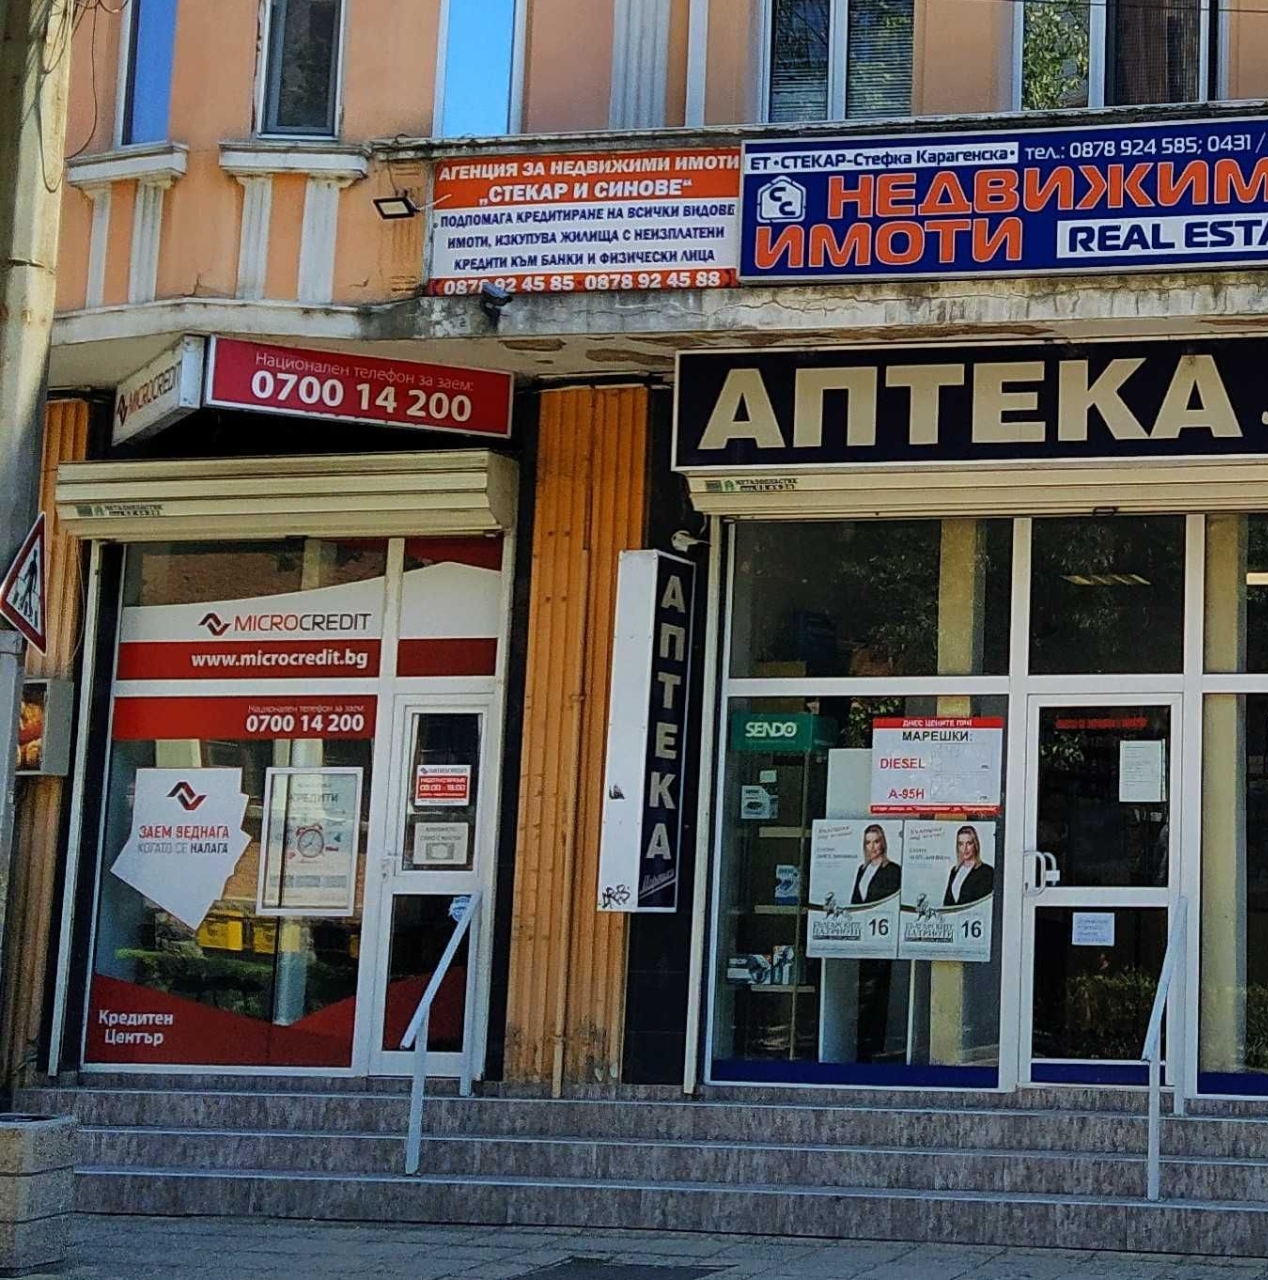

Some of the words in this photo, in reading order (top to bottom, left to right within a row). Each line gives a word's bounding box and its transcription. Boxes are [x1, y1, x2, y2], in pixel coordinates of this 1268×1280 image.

[750, 156, 770, 170] ЕТ
[1024, 146, 1065, 160] тел.:
[1069, 141, 1116, 158] 0878
[1121, 139, 1157, 156] 924
[1161, 137, 1203, 154] 585;
[1208, 134, 1251, 152] 0431
[438, 163, 518, 181] АГЕНЦИЯ
[522, 162, 545, 177] ЗА
[550, 157, 670, 177] НЕДВИЖИМИ
[675, 155, 740, 170] ИМОТИ
[573, 182, 589, 199] И
[440, 212, 513, 228] ПОДПОМАГА
[516, 208, 604, 224] КРЕДИТИРАНЕ
[607, 207, 624, 219] НА
[628, 205, 679, 219] ВСИЧКИ
[683, 204, 736, 218] ВИДОВЕ
[447, 236, 492, 249] ИМОТИ,
[495, 232, 557, 247] ИЗКУПУВА
[560, 229, 619, 244] ЖИЛИЩА
[622, 229, 631, 241] С
[634, 226, 725, 241] НЕИЗПЛАТЕНИ
[754, 217, 1023, 269] ИМОТИ
[1069, 222, 1175, 252] REAL
[454, 258, 507, 271] КРЕДИТИ
[510, 255, 537, 268] КЪМ
[541, 253, 583, 266] БАНКИ
[587, 253, 596, 264] И
[600, 251, 678, 264] ФИЗИЧЕСКИ
[681, 249, 715, 262] ЛИЦА
[521, 277, 545, 292] 45
[550, 275, 574, 291] 85
[584, 273, 633, 290] 0878
[638, 273, 662, 288] 92
[667, 272, 691, 287] 45
[256, 352, 349, 377] Национален
[353, 365, 415, 387] телефон
[419, 374, 434, 387] за
[437, 377, 474, 392] заем:
[251, 370, 344, 407] 0700
[356, 383, 397, 413] 14
[406, 389, 473, 422] 200
[696, 354, 1245, 451] АПТЕКА
[233, 613, 372, 631] MICROCREDIT
[191, 648, 368, 669] www.microcredit.bg
[246, 715, 294, 732] 0700
[301, 715, 323, 731] 14
[327, 714, 364, 731] 200
[645, 574, 687, 860] АПТЕКА
[745, 722, 798, 737] SENDO
[902, 731, 973, 742] МАРЕШКИ:
[880, 758, 925, 769] DIESEL
[139, 825, 172, 839] ЗАЕМ
[138, 842, 172, 854] КОГАТО
[175, 842, 187, 854] СЕ
[190, 842, 228, 854] НАЛАГА
[868, 919, 889, 936] 16
[961, 920, 982, 938] 16
[98, 1009, 174, 1026] Кредитен
[104, 1029, 164, 1047] Център
